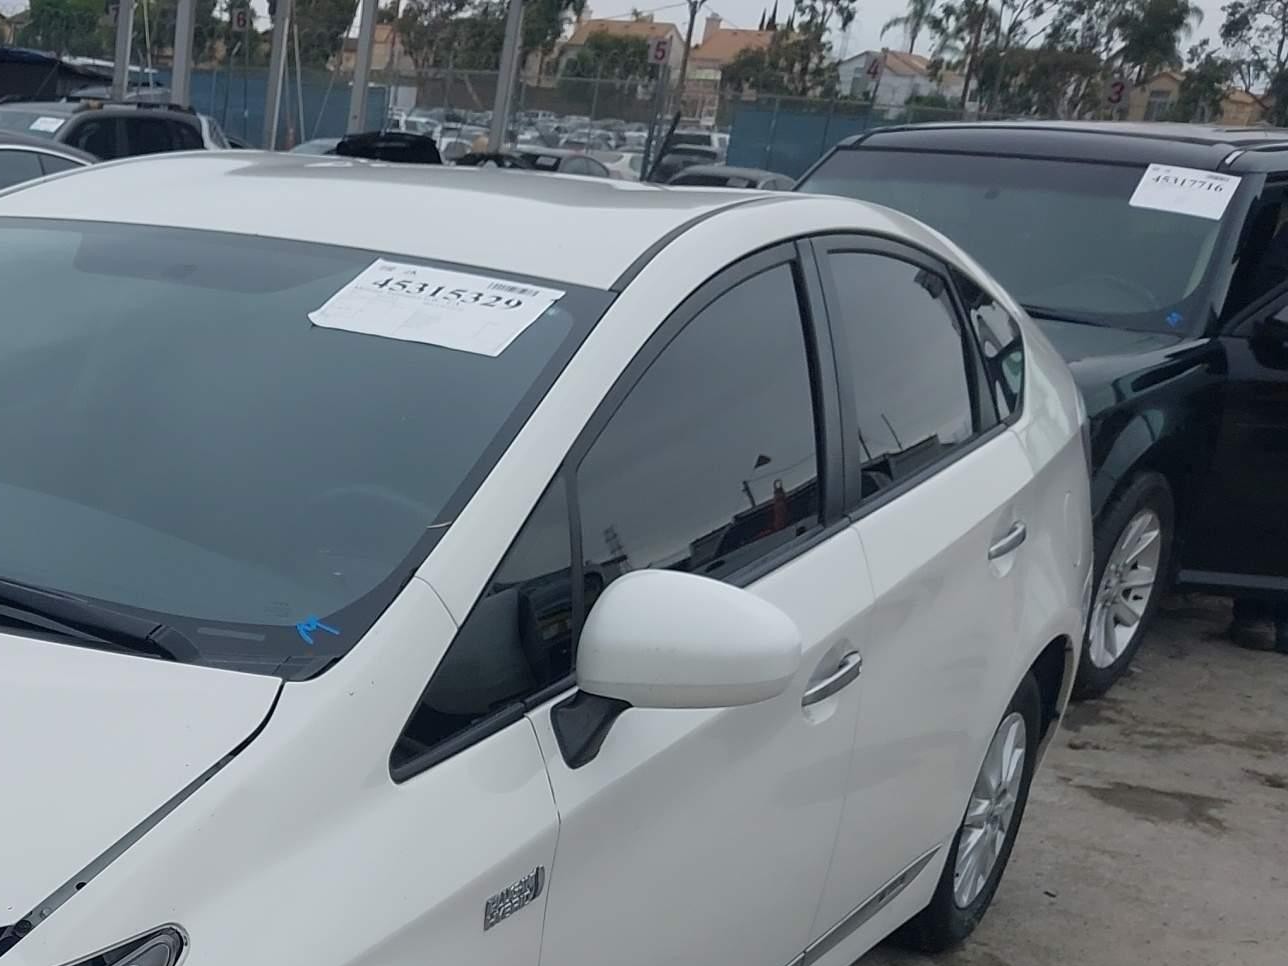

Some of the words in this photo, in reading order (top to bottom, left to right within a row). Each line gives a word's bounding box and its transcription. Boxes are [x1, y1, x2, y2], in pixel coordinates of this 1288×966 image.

[236, 11, 247, 28] 6
[654, 41, 667, 61] 5
[867, 57, 880, 79] 4
[1108, 81, 1125, 104] 3
[372, 276, 524, 310] 45315329
